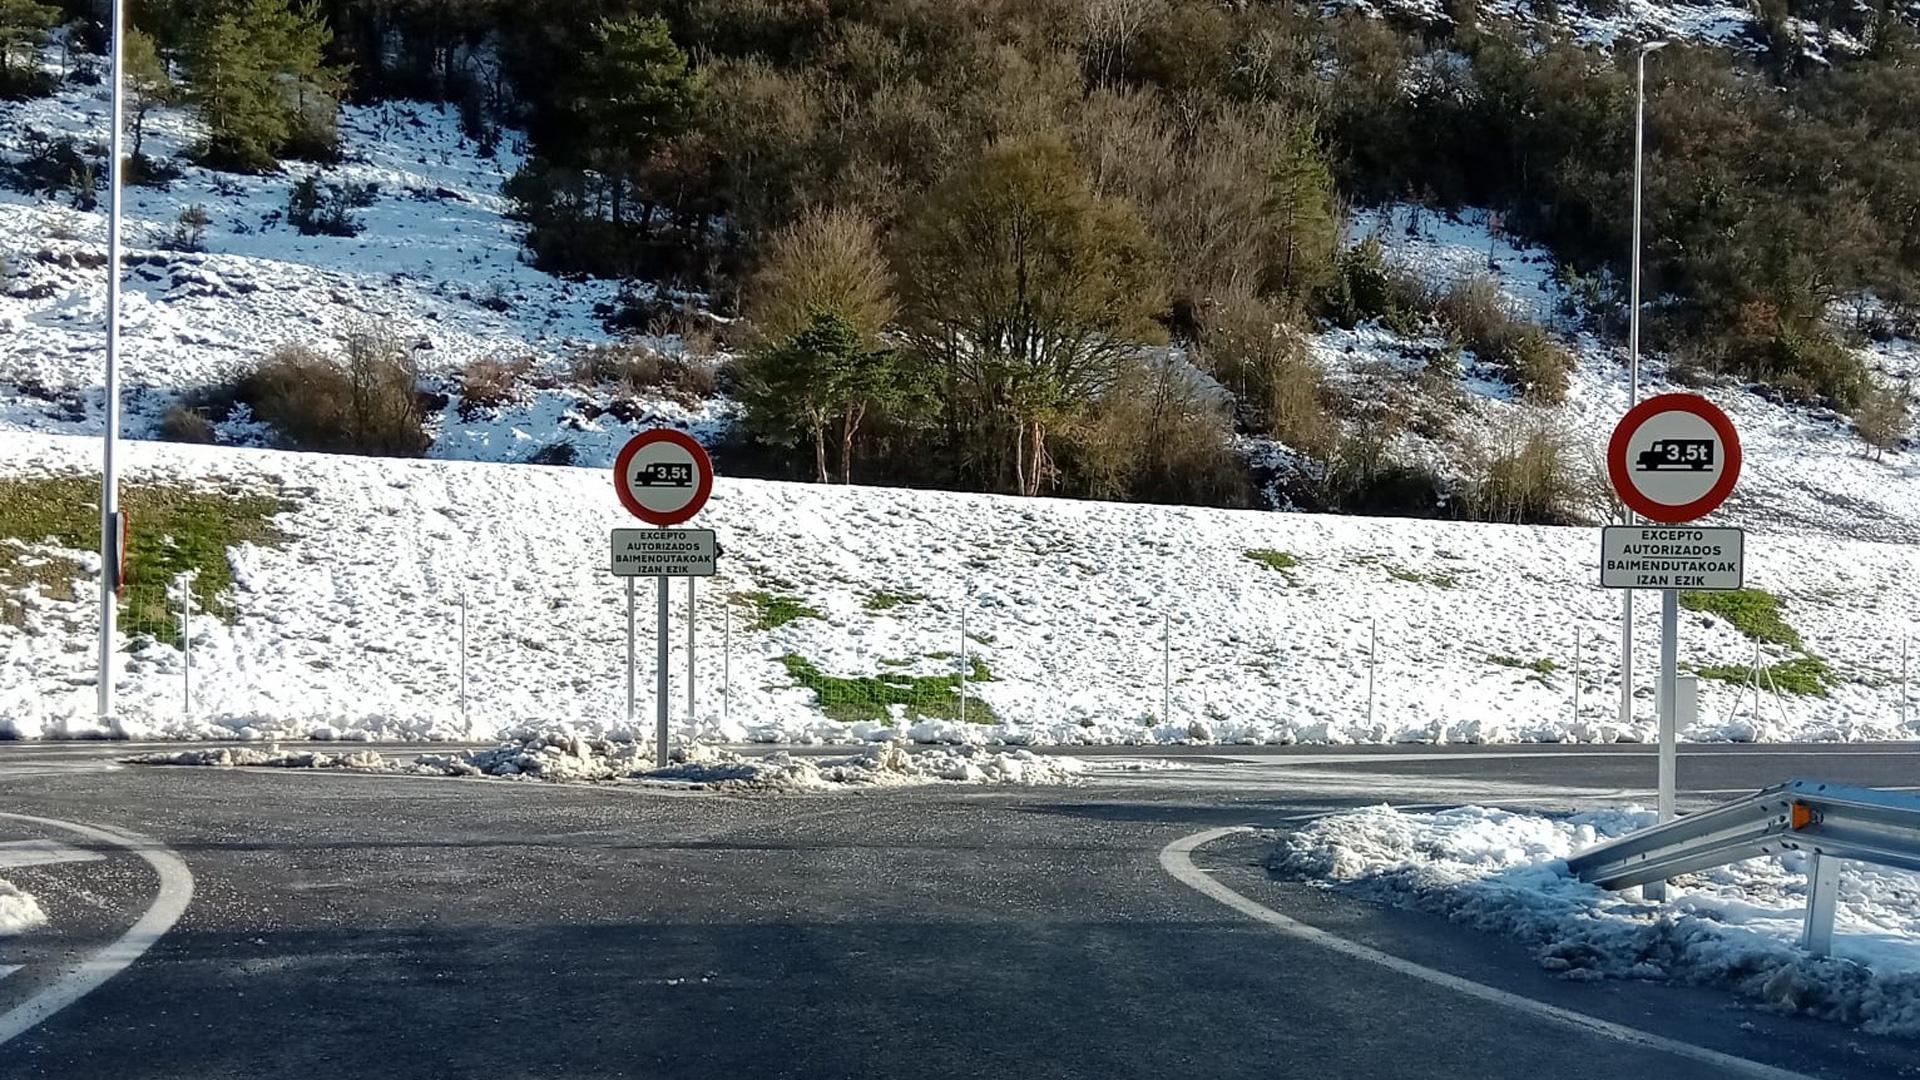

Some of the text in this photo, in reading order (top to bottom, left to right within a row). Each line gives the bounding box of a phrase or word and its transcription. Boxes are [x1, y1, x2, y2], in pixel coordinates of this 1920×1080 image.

[1666, 444, 1708, 462] 3,5t
[657, 467, 688, 480] 3,5t
[640, 532, 686, 540] EXCEPTO
[1641, 530, 1703, 541] EXCEPTO
[627, 542, 700, 551] AUTORIZADOS
[1623, 544, 1722, 556] AUTORIZADOS
[615, 554, 711, 563] BAIMENDUTAKOAK
[638, 565, 689, 573] IZAN EZIK
[1607, 560, 1736, 572] BAIMENDUTAKOAK
[1636, 575, 1705, 586] IZAN EZIK
